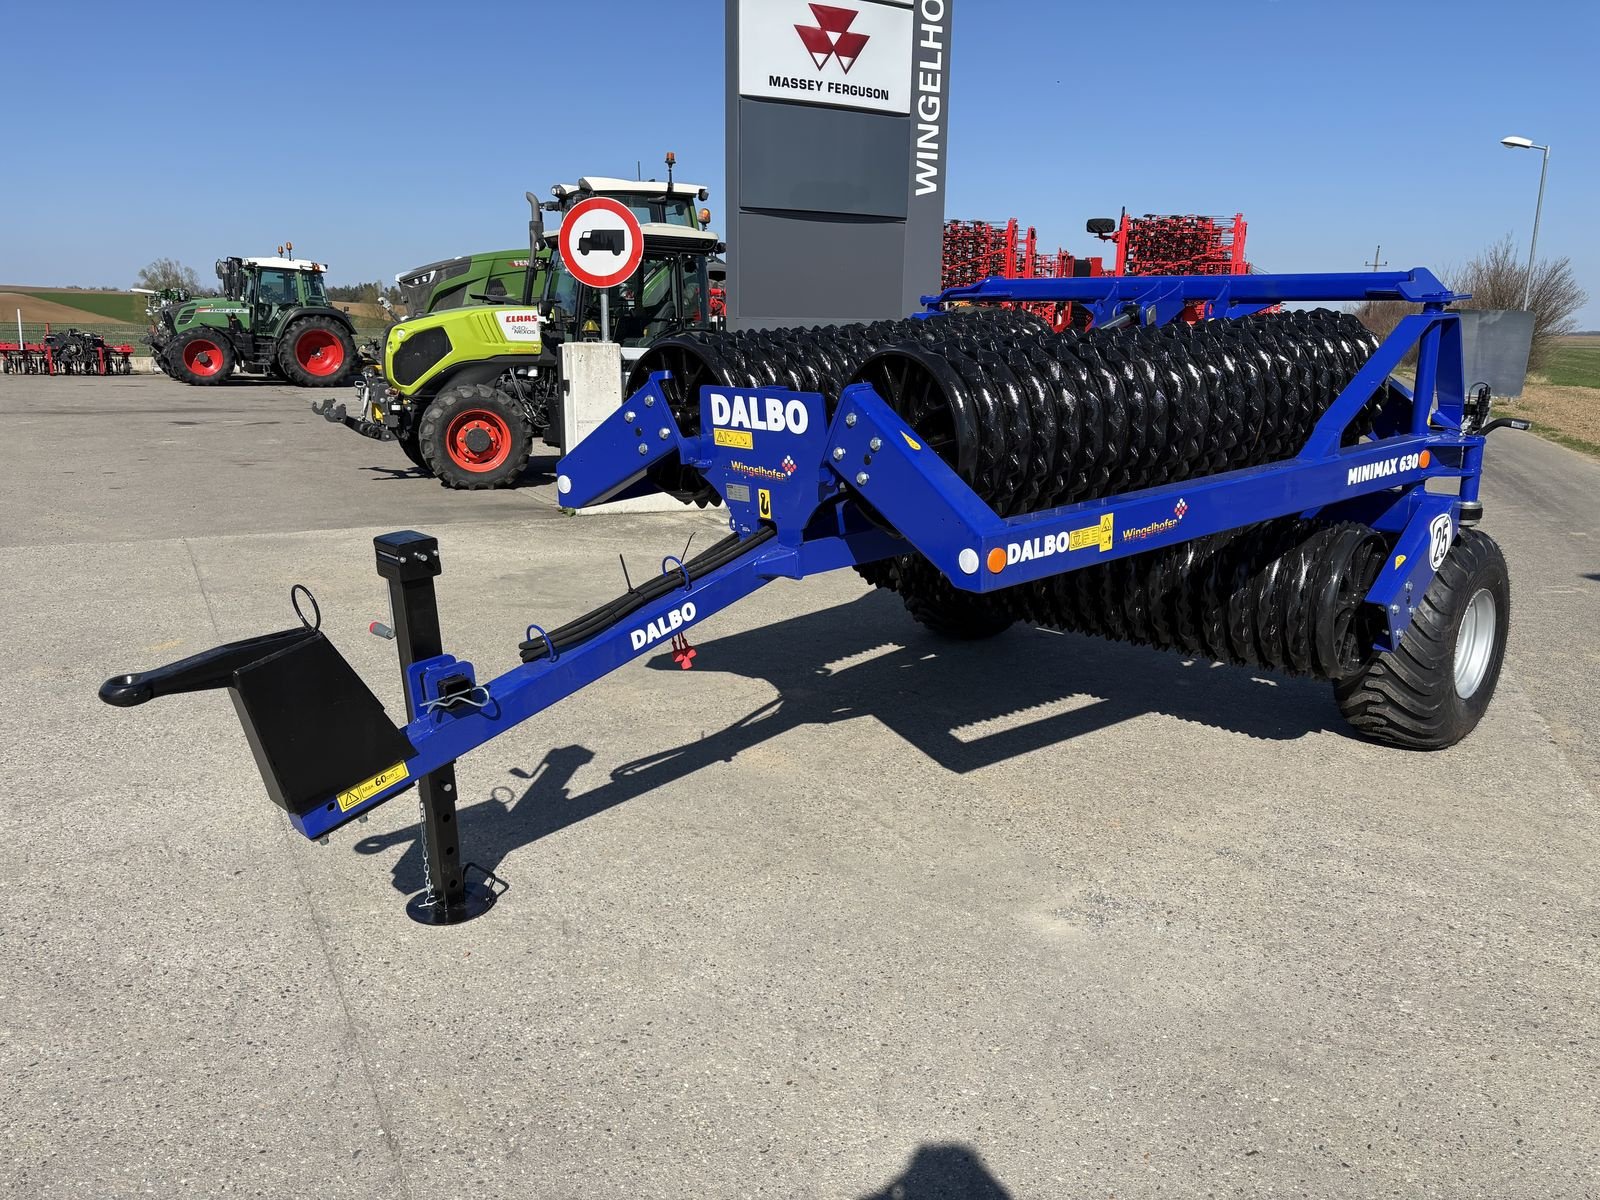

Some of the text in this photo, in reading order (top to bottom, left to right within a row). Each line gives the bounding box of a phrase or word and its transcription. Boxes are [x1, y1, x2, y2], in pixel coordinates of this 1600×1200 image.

[769, 75, 889, 100] MASSEY FERGUSON
[506, 315, 538, 323] CLAAS
[710, 393, 808, 435] DALBO
[731, 460, 786, 480] Wingelhofer
[1347, 453, 1419, 485] MINIMAX 630
[1123, 518, 1178, 541] Wingelhofer
[1433, 522, 1449, 563] 25
[1007, 531, 1069, 565] DALBO
[630, 602, 696, 651] DALBO
[375, 775, 387, 787] 60
